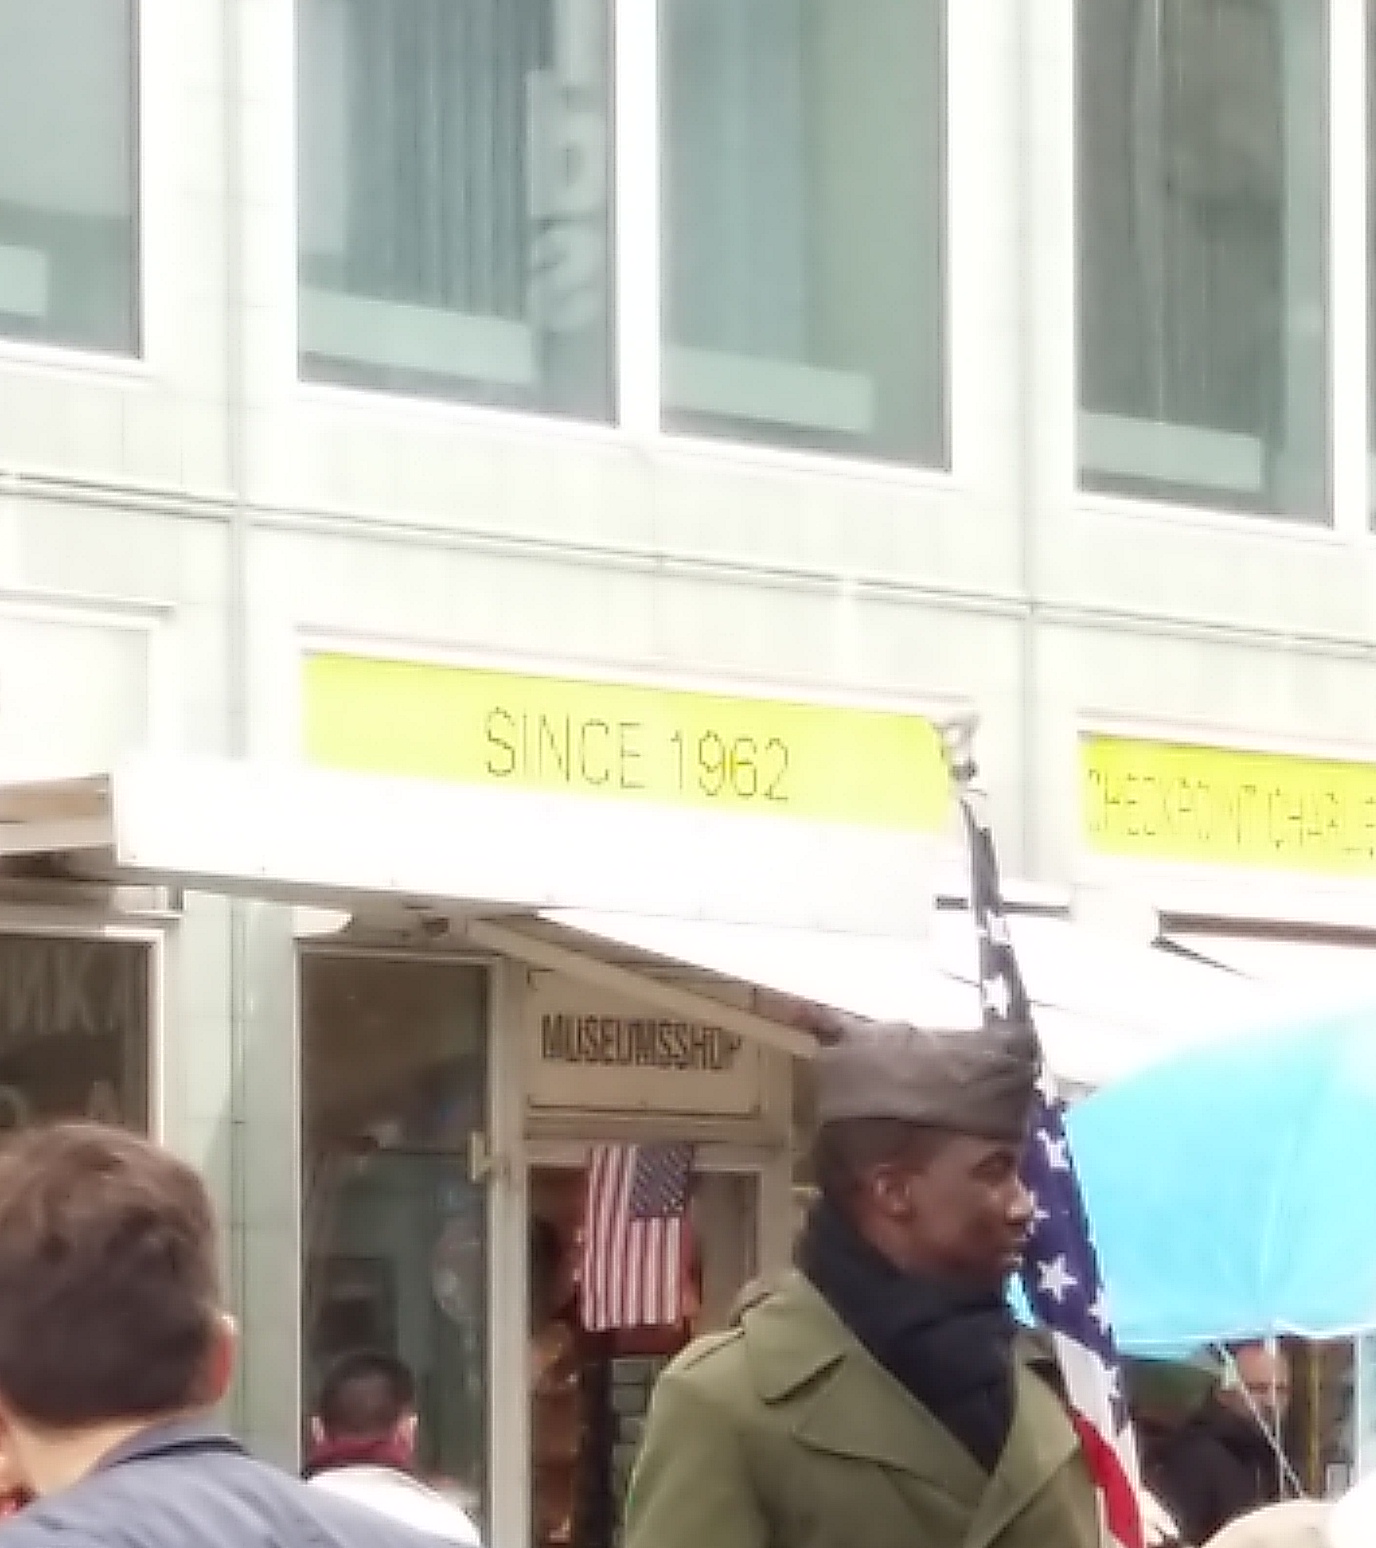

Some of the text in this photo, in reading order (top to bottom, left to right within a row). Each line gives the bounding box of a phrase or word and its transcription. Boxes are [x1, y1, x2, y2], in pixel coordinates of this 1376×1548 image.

[485, 705, 789, 802] SINCE 1962
[1087, 766, 1258, 850] CHECKPONT
